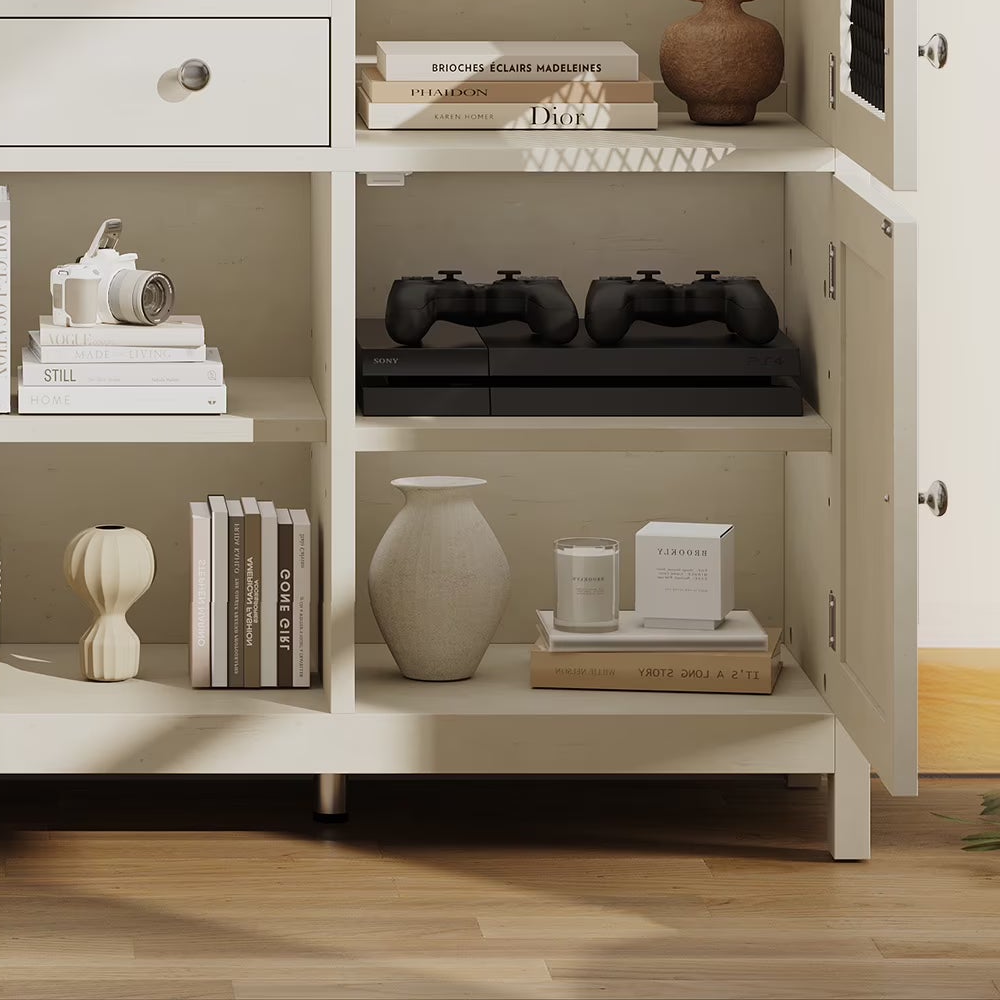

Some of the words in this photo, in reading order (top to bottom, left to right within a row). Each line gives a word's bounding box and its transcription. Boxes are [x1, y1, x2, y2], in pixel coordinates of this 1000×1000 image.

[431, 63, 485, 73] BRIOCHES
[490, 61, 532, 73] ÉCLAIRS
[536, 63, 602, 73] MADELEINES
[411, 88, 489, 97] PHAIDON
[529, 105, 585, 126] Dior
[74, 349, 111, 359] MADE
[128, 349, 172, 359] LIVING
[43, 368, 77, 382] STILL
[30, 395, 71, 405] HOME
